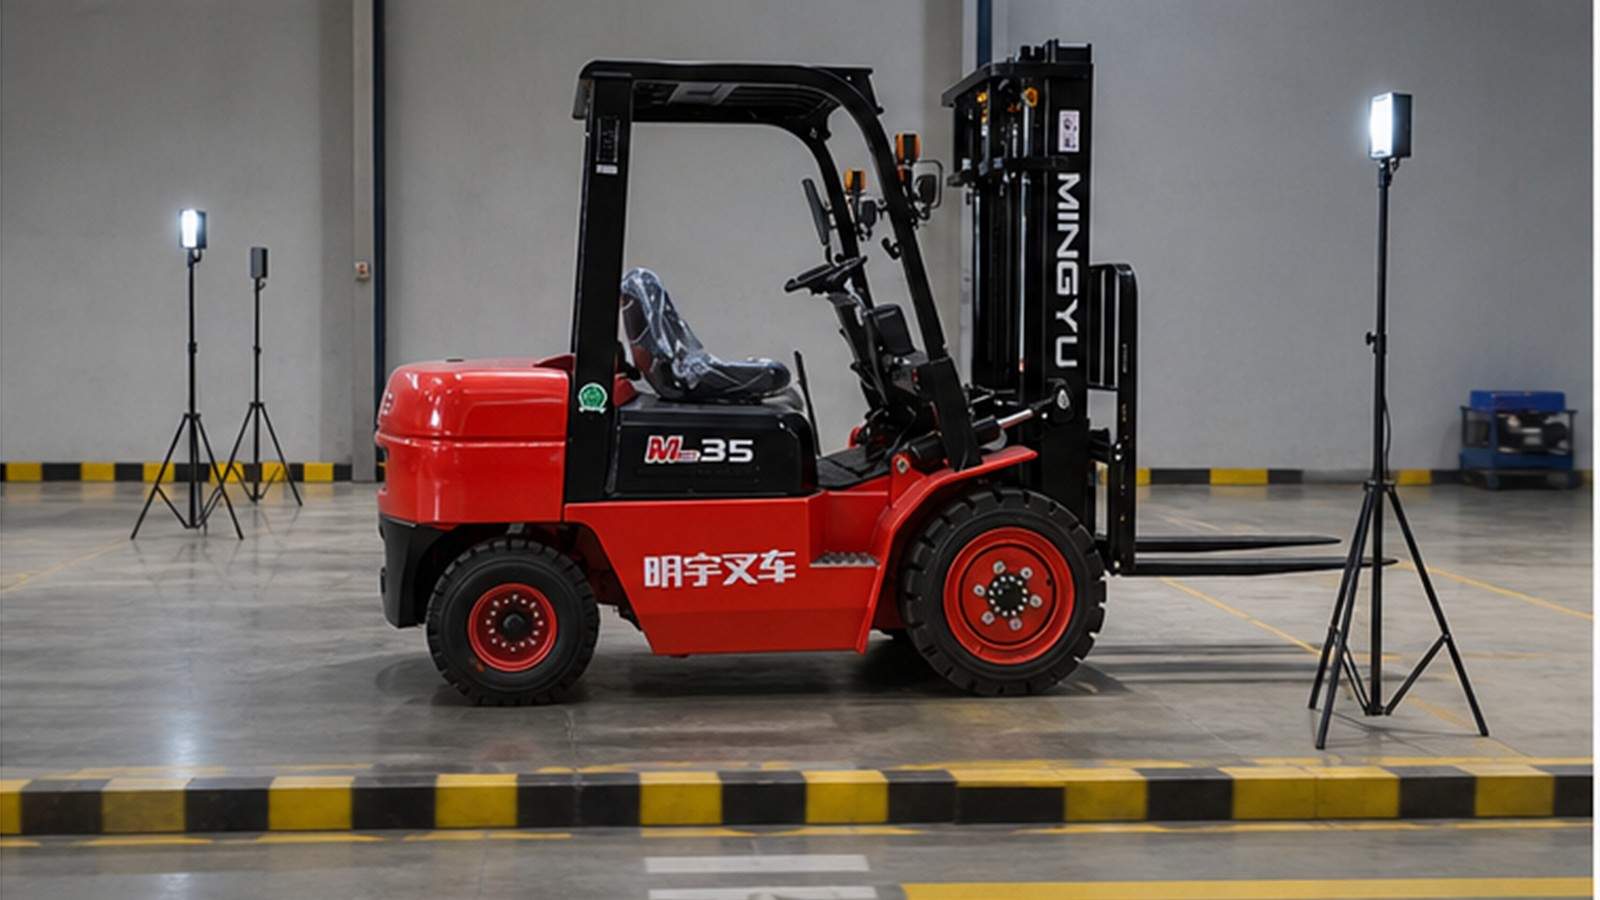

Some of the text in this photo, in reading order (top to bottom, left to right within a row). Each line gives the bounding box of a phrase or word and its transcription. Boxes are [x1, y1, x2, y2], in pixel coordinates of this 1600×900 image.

[1056, 173, 1080, 367] MINGYU
[700, 438, 753, 462] 35
[644, 549, 796, 588] 明宇叉车
